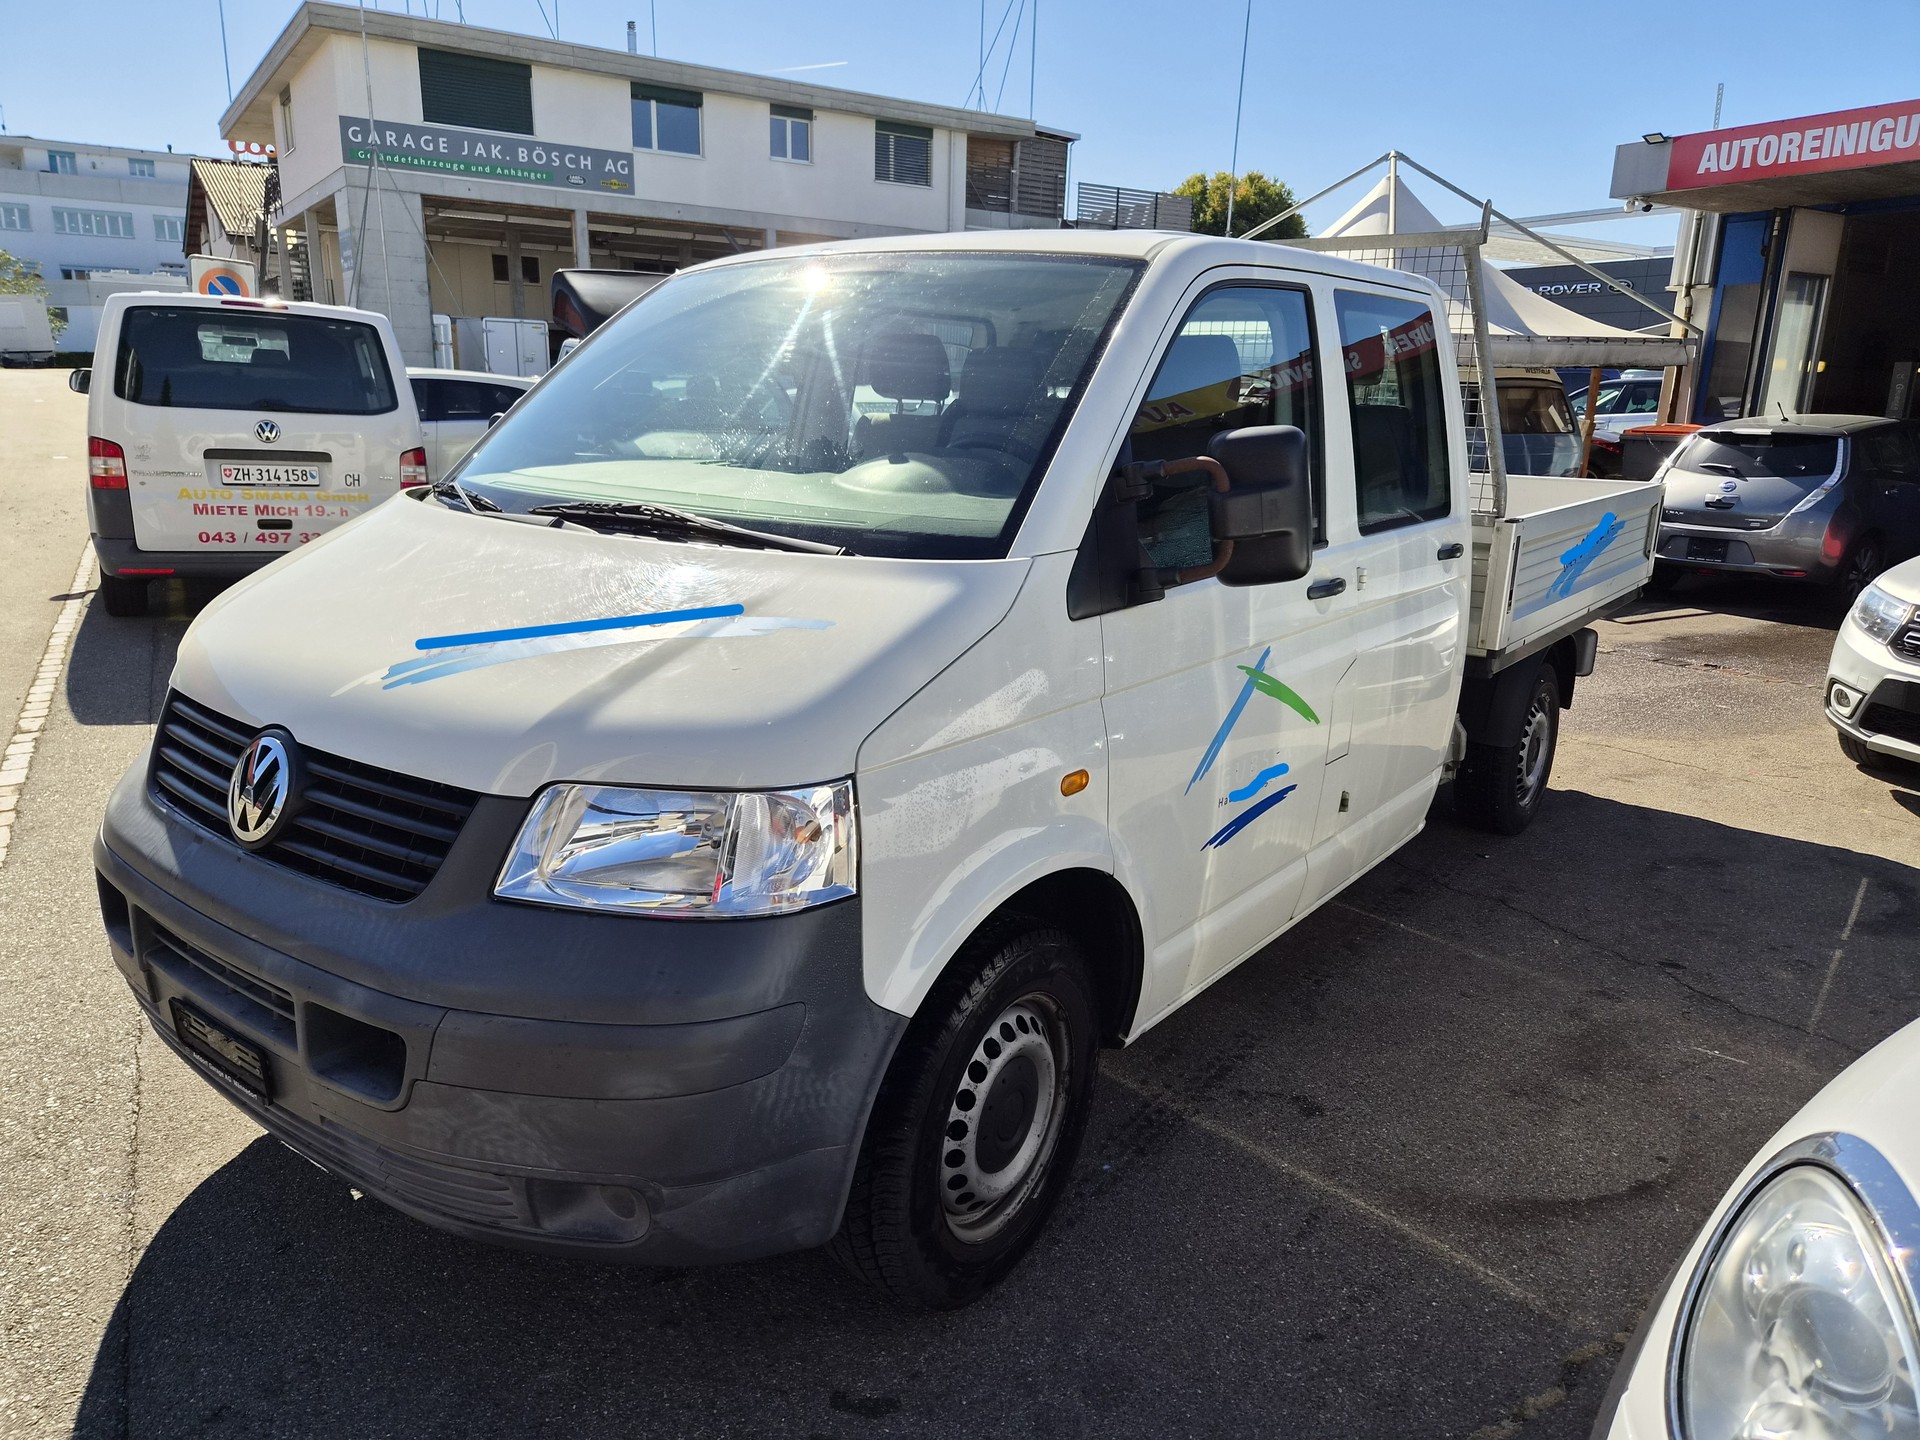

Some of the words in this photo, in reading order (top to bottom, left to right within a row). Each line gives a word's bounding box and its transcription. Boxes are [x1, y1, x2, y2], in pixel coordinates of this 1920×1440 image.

[348, 126, 448, 153] GARAGE
[461, 140, 510, 161] JAK.
[518, 146, 592, 171] BÖSCH
[604, 158, 629, 175] AG
[1697, 113, 1920, 174] AUTOREINIGU
[358, 150, 465, 171] Geändefahrzeuge
[471, 164, 491, 174] und
[496, 167, 547, 180] Anhänger
[1539, 282, 1602, 296] ROVER
[344, 473, 361, 487] CH
[177, 487, 234, 500] AUTO
[241, 489, 309, 502] SMAKA
[314, 490, 370, 503] GmbH
[198, 531, 237, 544] 043
[255, 532, 292, 544] 497
